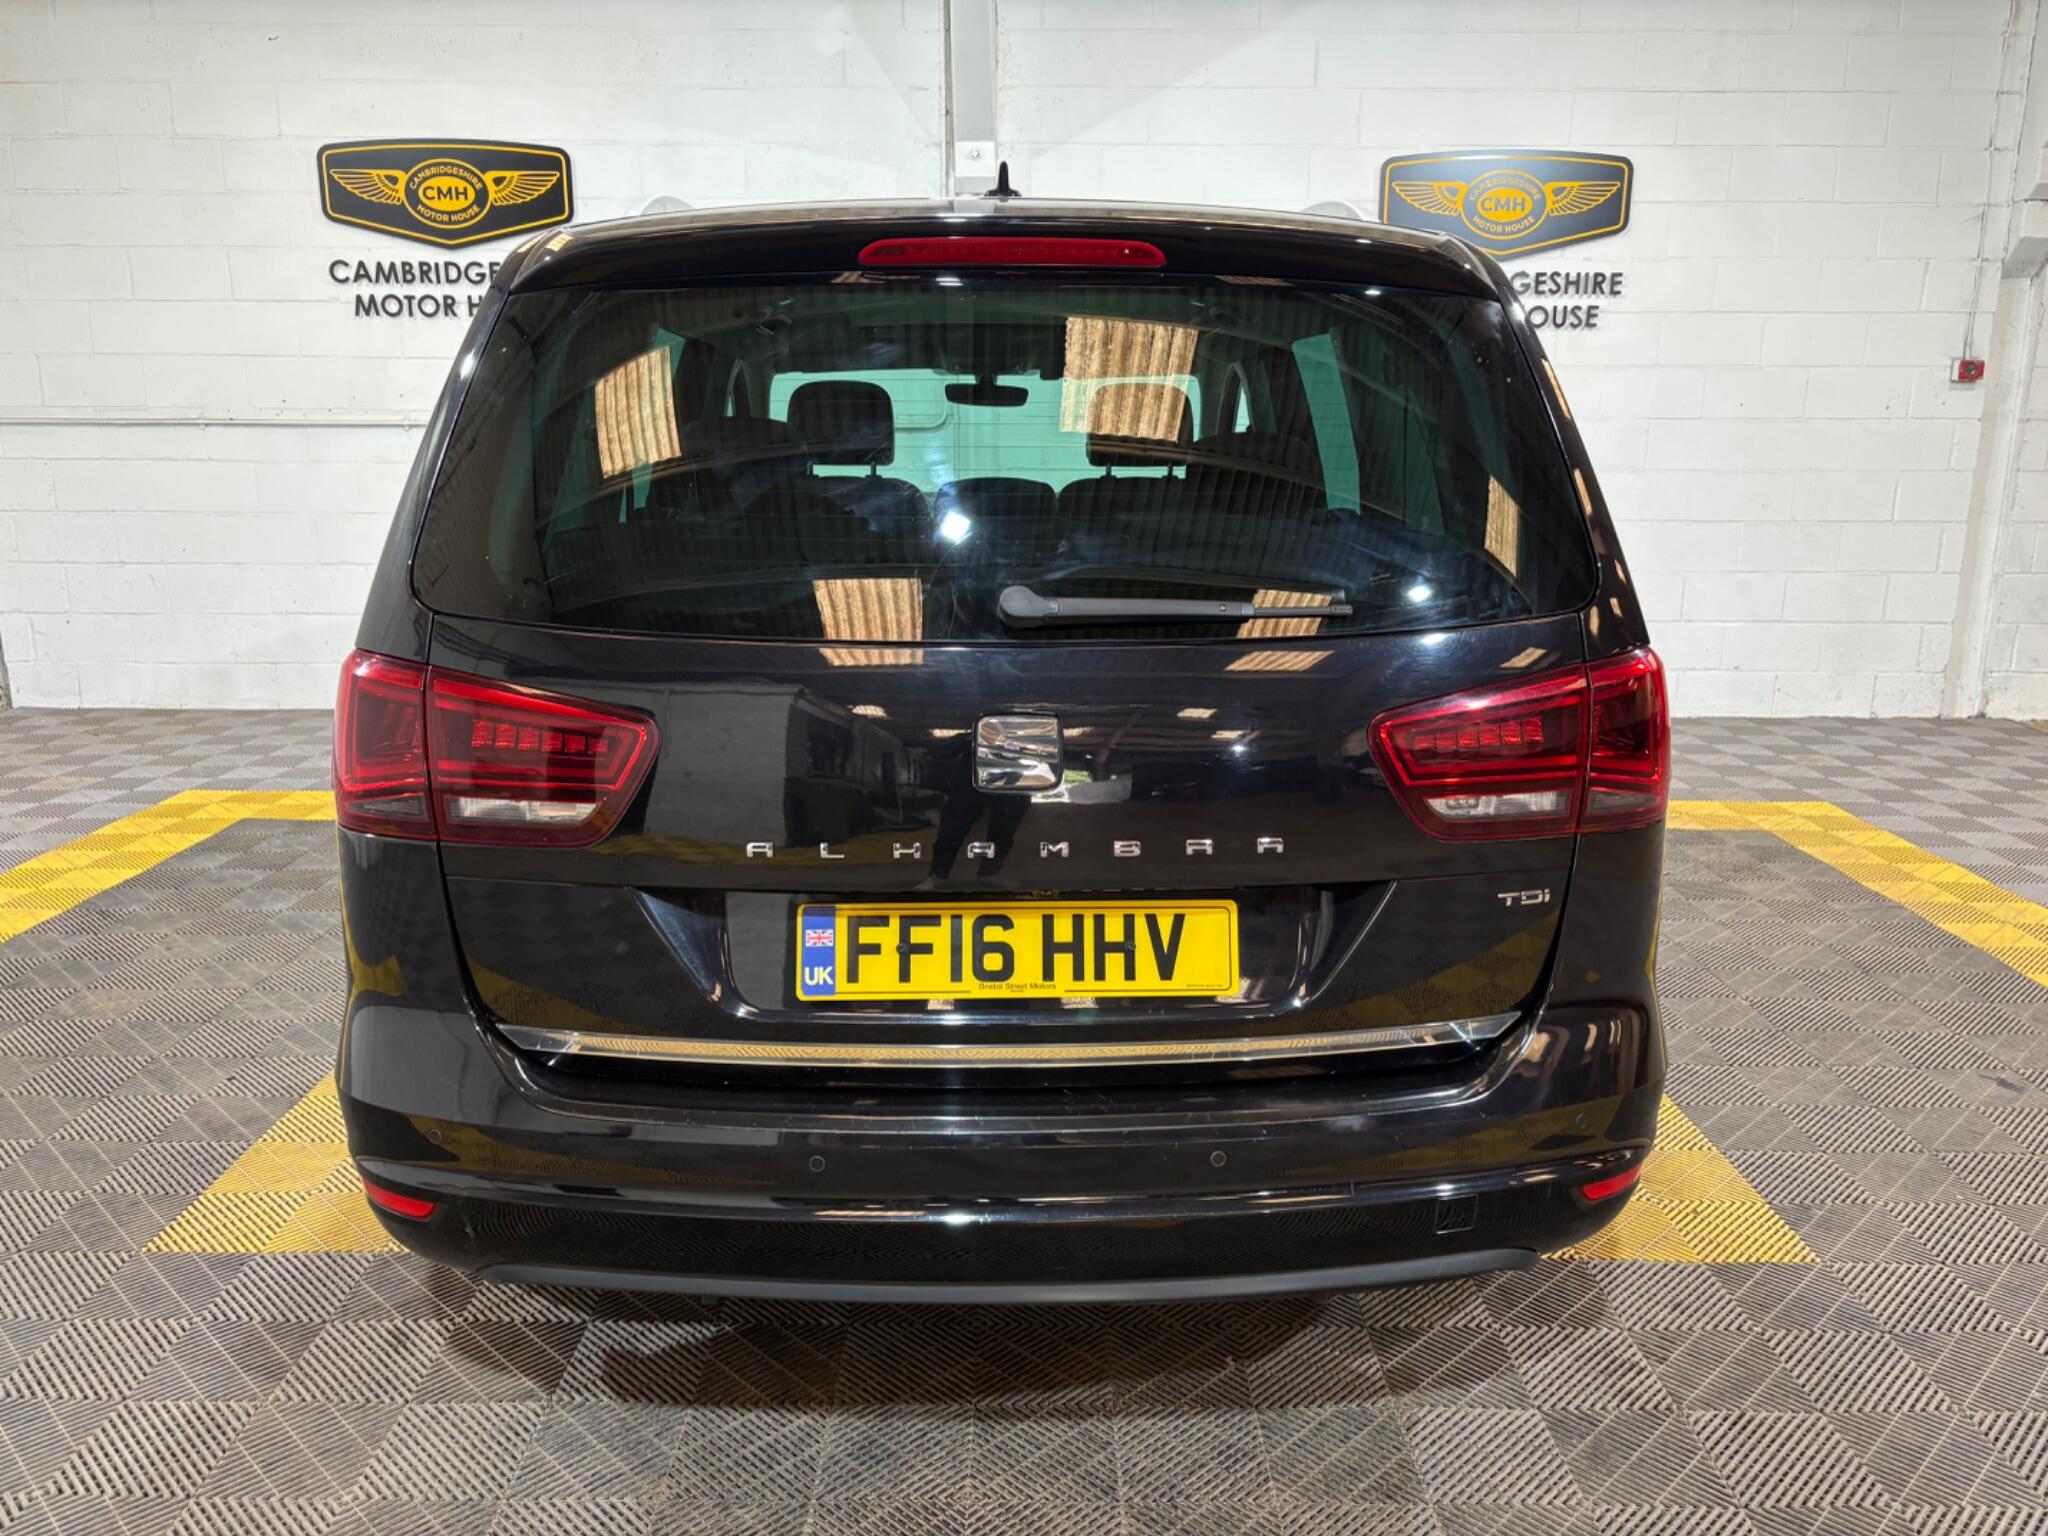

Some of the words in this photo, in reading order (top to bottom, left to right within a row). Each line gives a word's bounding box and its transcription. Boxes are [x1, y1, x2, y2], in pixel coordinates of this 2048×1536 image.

[409, 165, 483, 190] CAMBRIDGESHIRE
[422, 186, 469, 201] CMH
[417, 204, 449, 222] MOTOR
[451, 204, 481, 222] HOUSE
[1481, 196, 1527, 212] CMH
[1472, 216, 1503, 233] MOTOR
[1505, 215, 1535, 233] HOUSE
[354, 294, 458, 317] MOTOR
[746, 836, 1285, 860] ALHAMBRA
[846, 914, 1015, 983] FF16
[1041, 913, 1186, 982] HHV
[804, 966, 833, 985] UK
[1030, 982, 1056, 990] Motors
